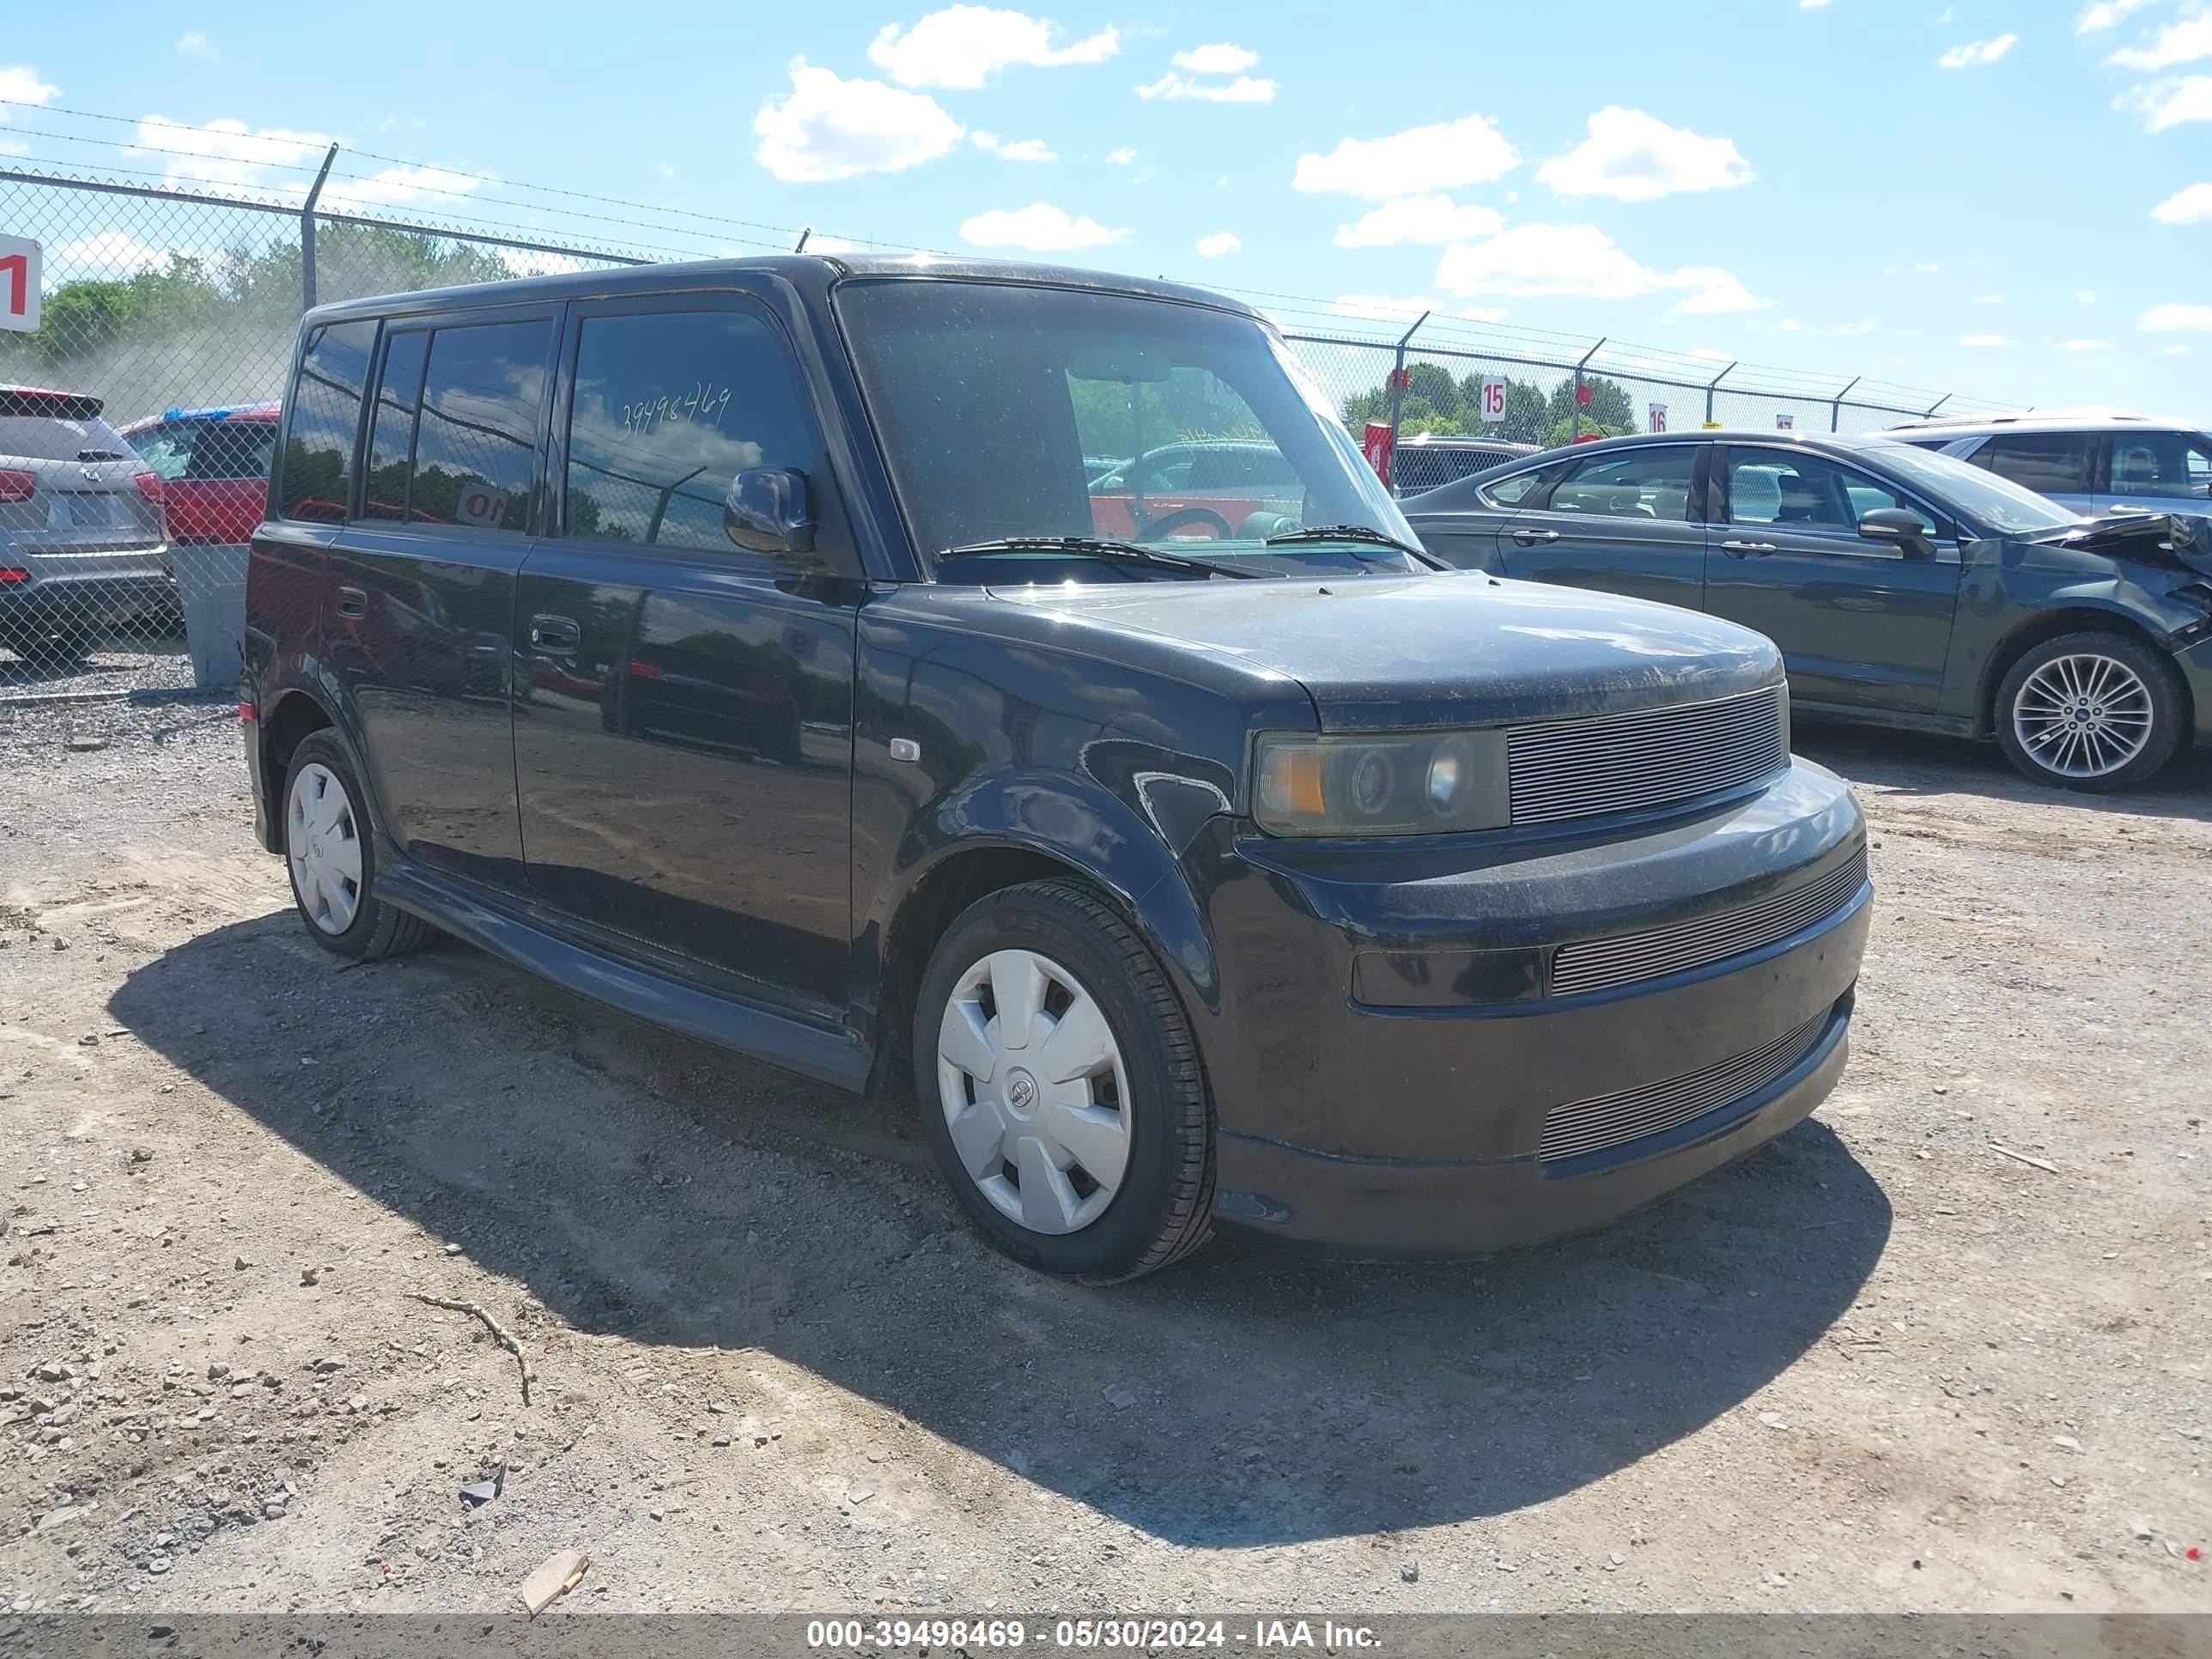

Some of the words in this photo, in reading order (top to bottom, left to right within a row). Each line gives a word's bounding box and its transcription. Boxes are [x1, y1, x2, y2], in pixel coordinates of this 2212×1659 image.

[618, 381, 732, 441] 39498469
[1483, 384, 1504, 413] 15
[1650, 410, 1665, 433] 16
